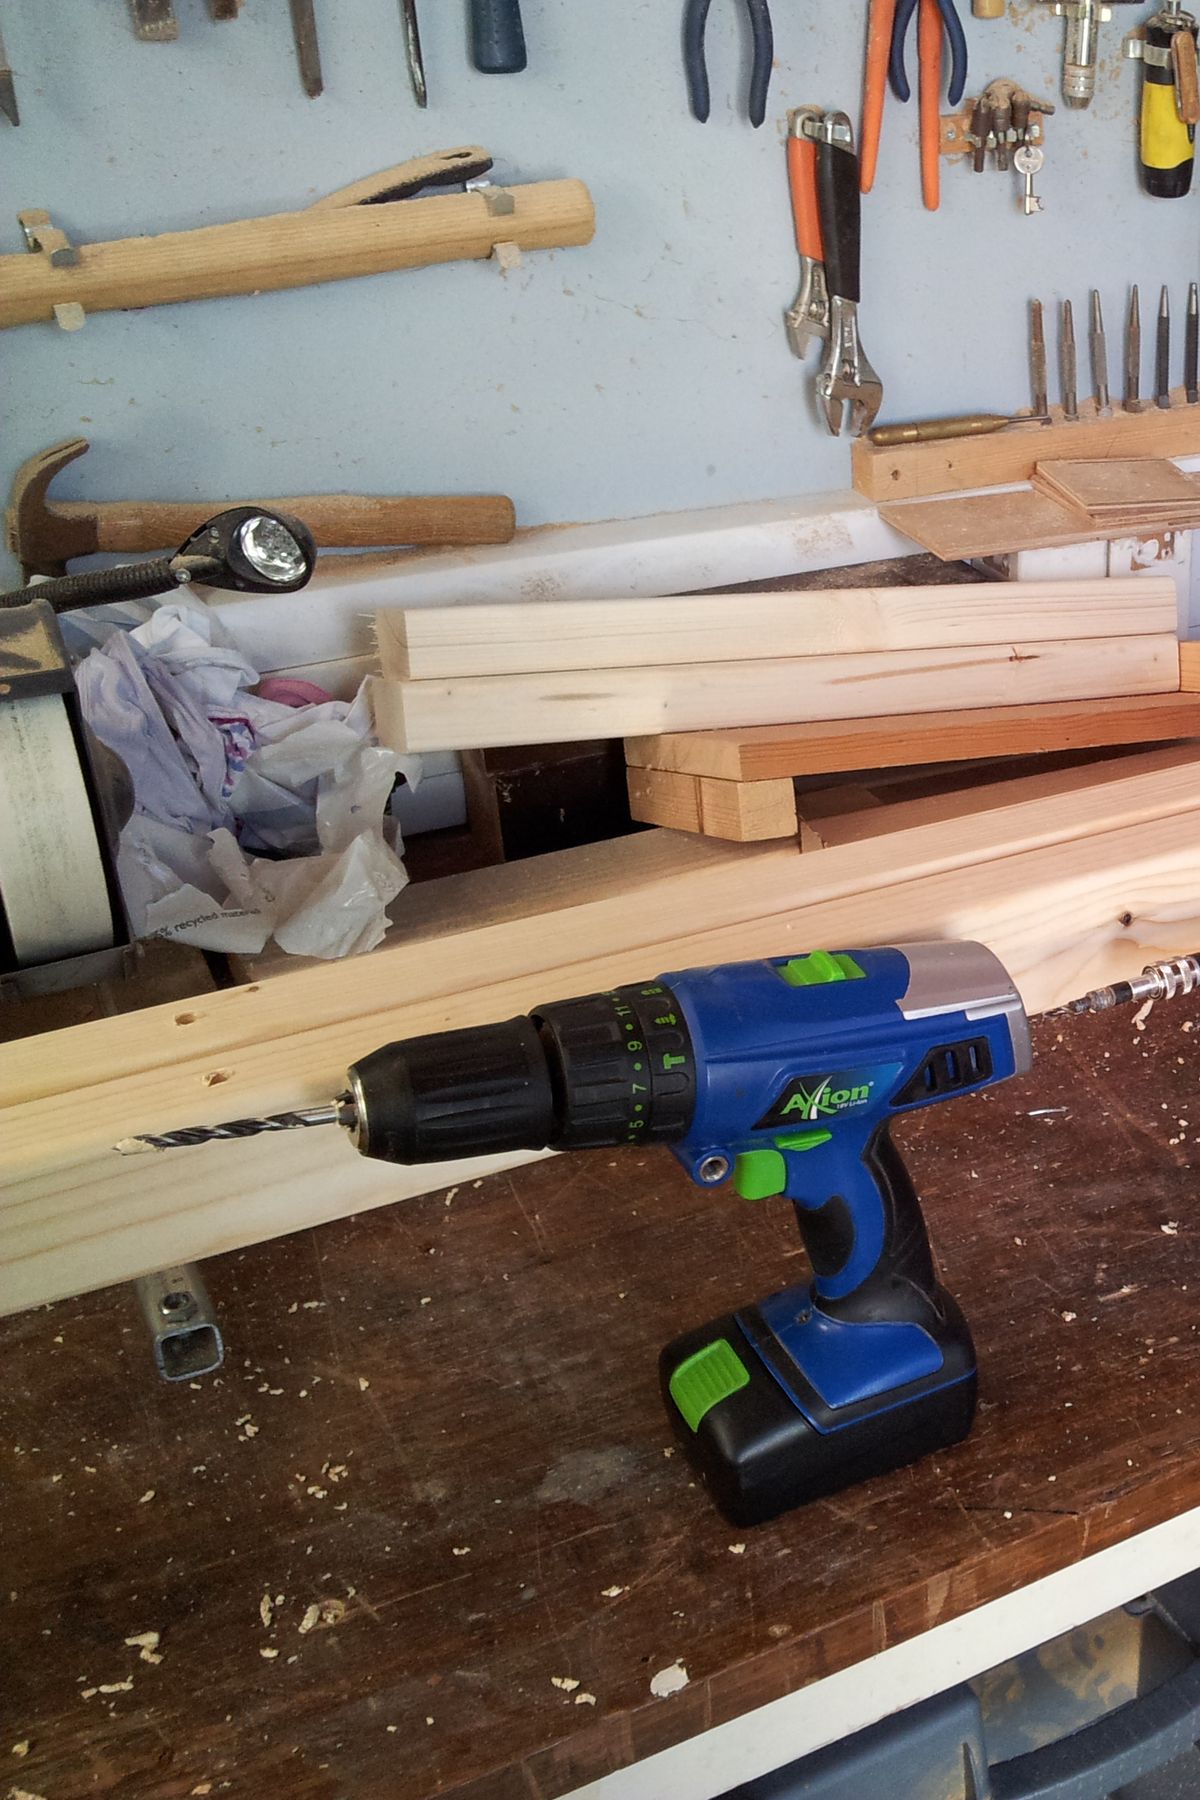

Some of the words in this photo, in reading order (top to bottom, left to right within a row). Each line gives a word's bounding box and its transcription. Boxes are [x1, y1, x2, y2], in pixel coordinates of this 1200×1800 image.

[174, 911, 219, 932] recycled
[614, 1005, 632, 1017] 11
[627, 1040, 643, 1051] 9
[632, 1083, 647, 1095] 7
[628, 1119, 645, 1129] 5
